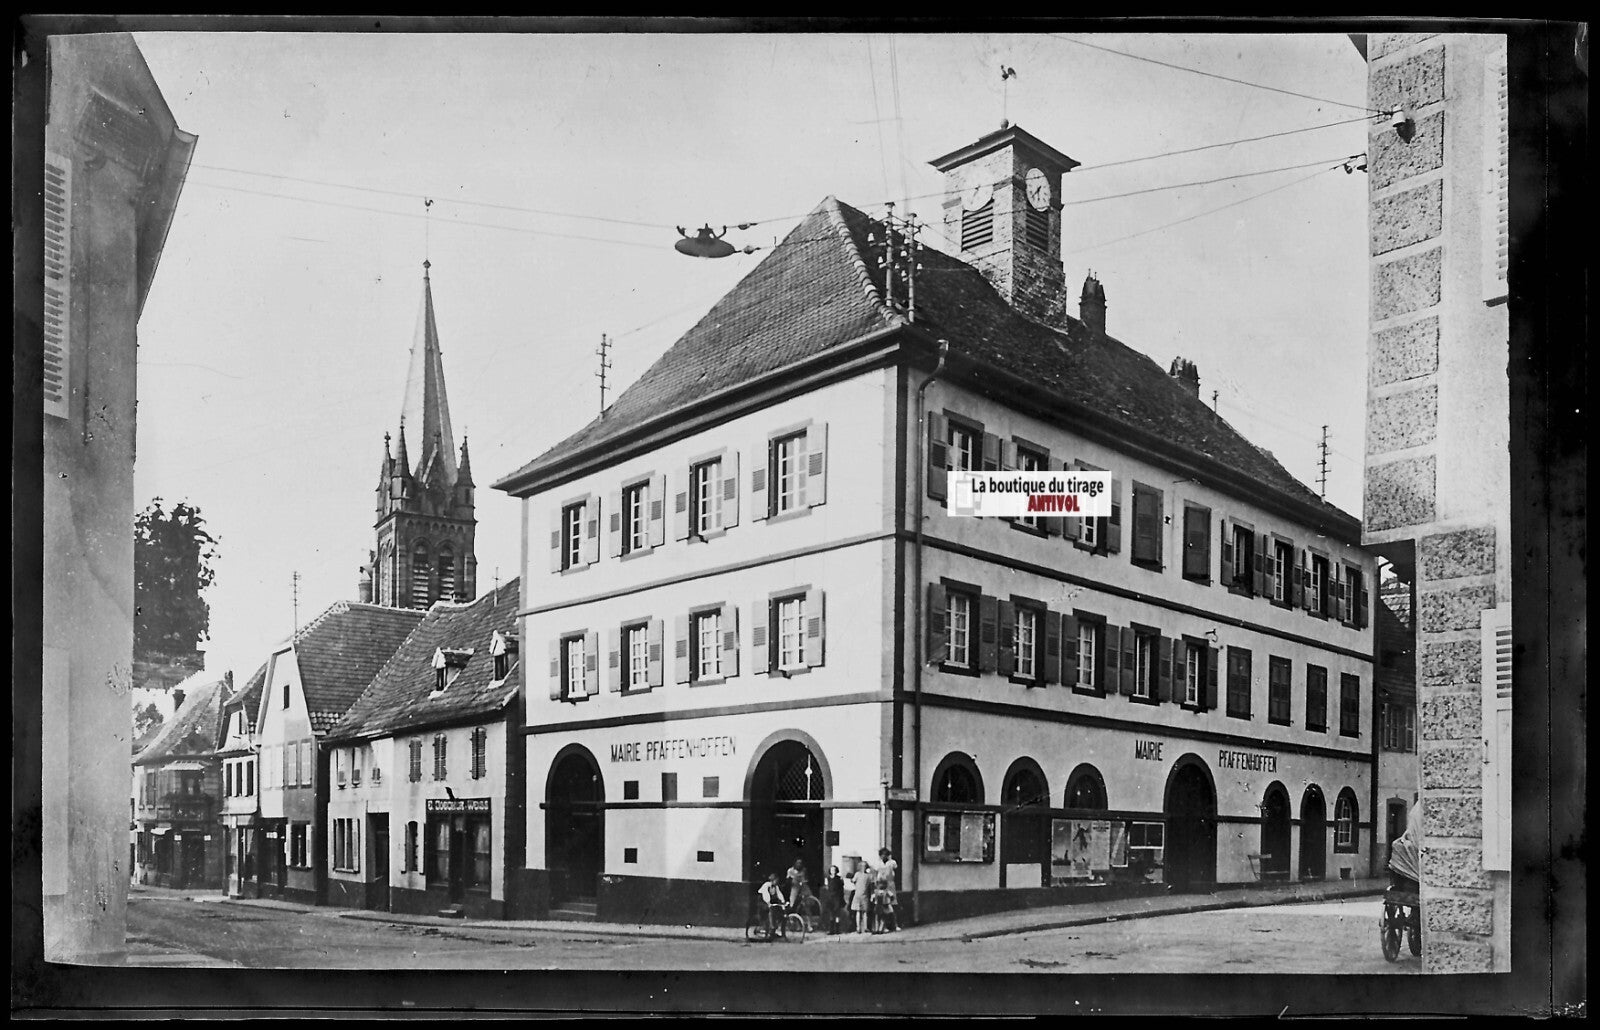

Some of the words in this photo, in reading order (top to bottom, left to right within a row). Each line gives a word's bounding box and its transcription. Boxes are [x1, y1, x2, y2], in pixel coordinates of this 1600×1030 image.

[611, 742, 641, 762] MAIRIE
[646, 736, 736, 760] PFAFFENHOFFEN
[1135, 739, 1164, 761] MAIRIE
[1218, 750, 1277, 773] PFAFFENHOFFEN
